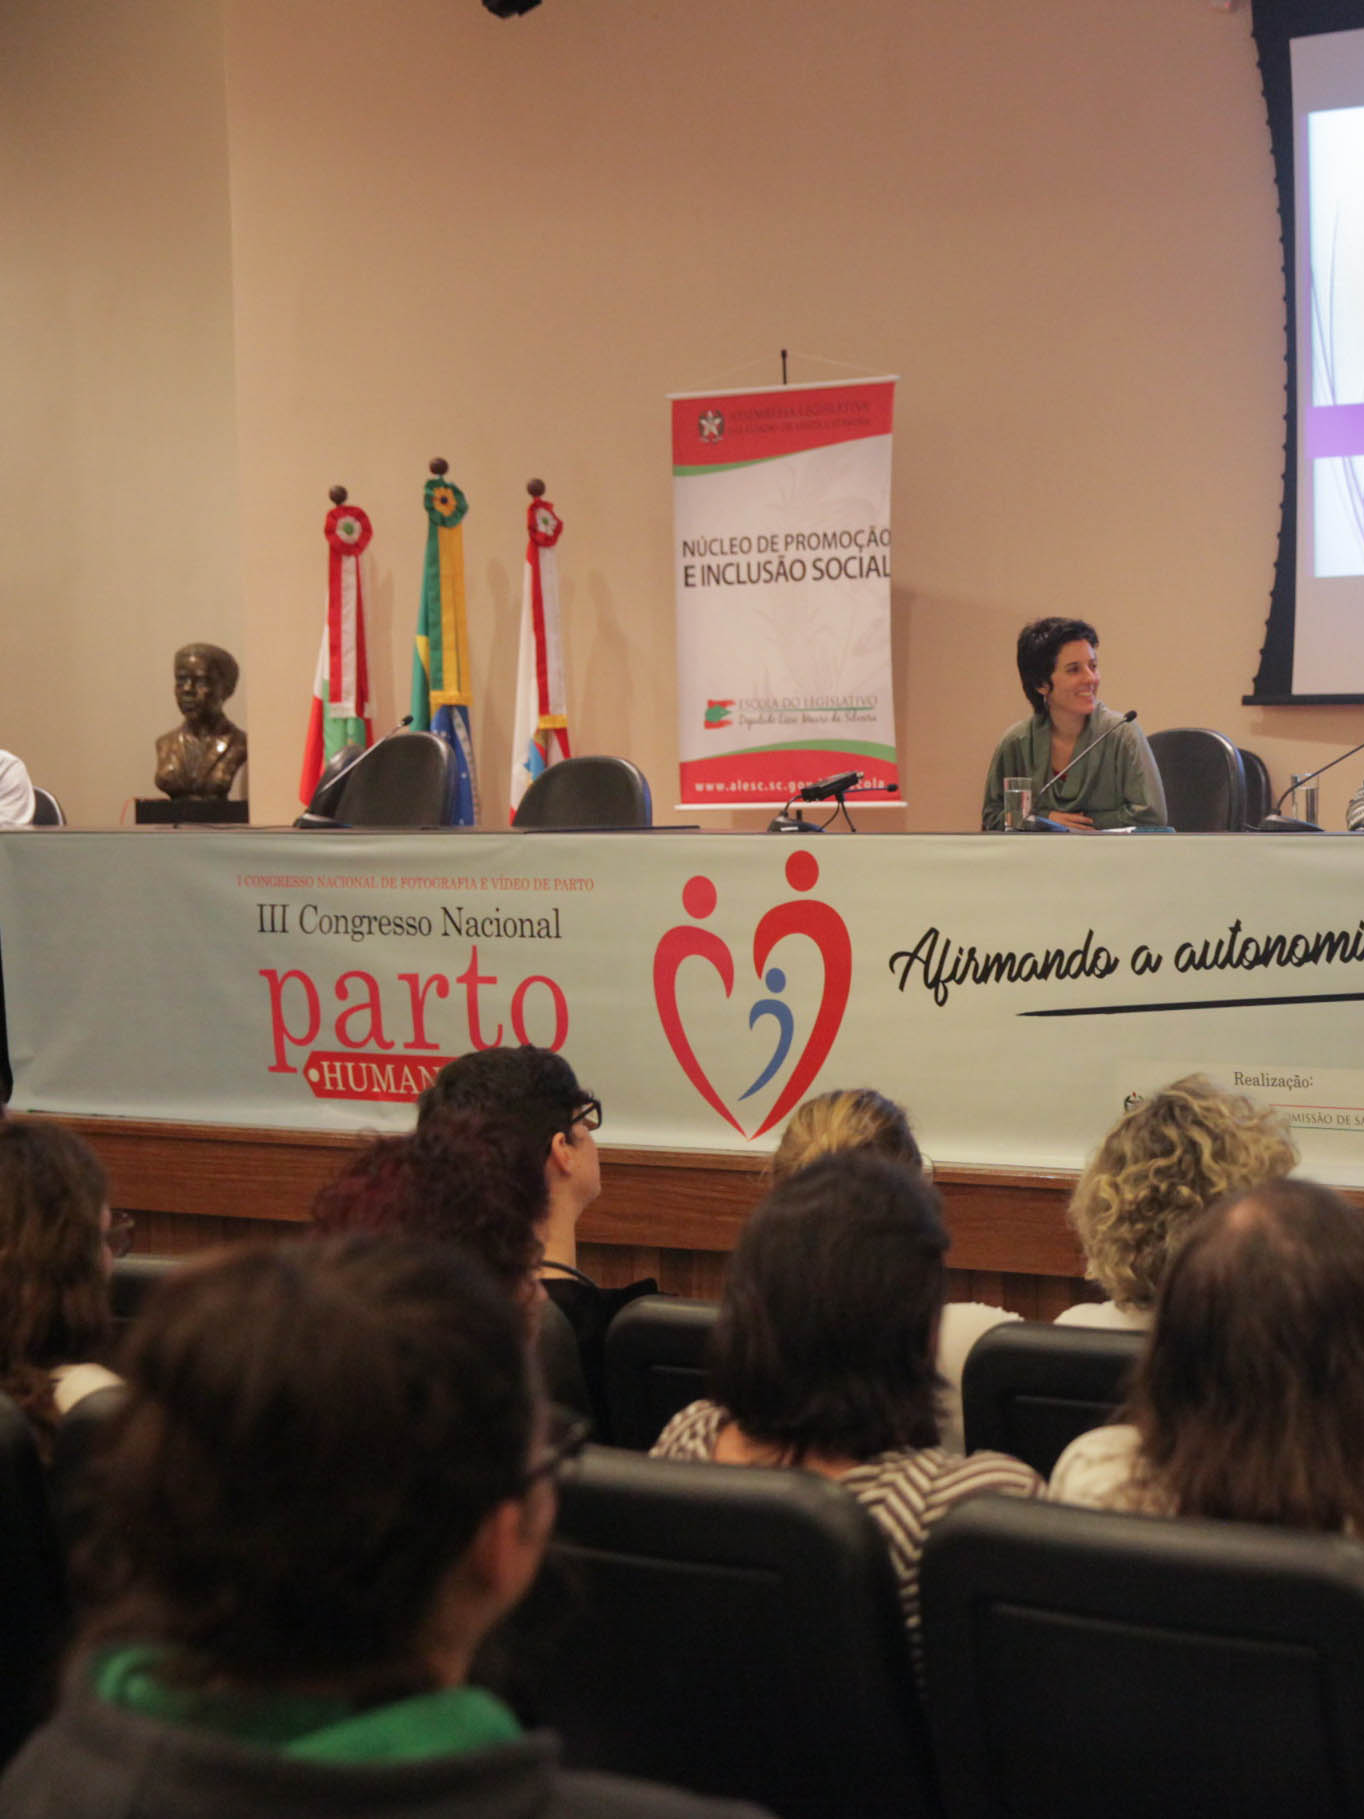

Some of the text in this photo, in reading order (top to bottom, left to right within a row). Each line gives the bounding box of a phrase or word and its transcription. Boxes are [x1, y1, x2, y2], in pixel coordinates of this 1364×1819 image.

[682, 526, 891, 557] NÚCLEO DE PROMOÇÃO
[684, 554, 890, 587] E INCLUSÃO SOCIAL
[243, 875, 314, 888] CONGRESSO
[318, 876, 378, 889] NACIONAL
[381, 877, 397, 889] DE
[401, 877, 477, 890] FOTOGRAFIA
[480, 878, 488, 890] E
[490, 875, 530, 891] VÍDEO
[534, 879, 550, 890] DE
[554, 879, 594, 892] PARTO
[257, 903, 562, 942] III Congresso Nacional
[888, 926, 1119, 1008] Afirmando
[1131, 944, 1162, 975] a
[258, 945, 569, 1074] parto
[320, 1061, 440, 1094] HUMAN
[1234, 1071, 1313, 1091] Realização:
[1336, 1114, 1351, 1126] DE
